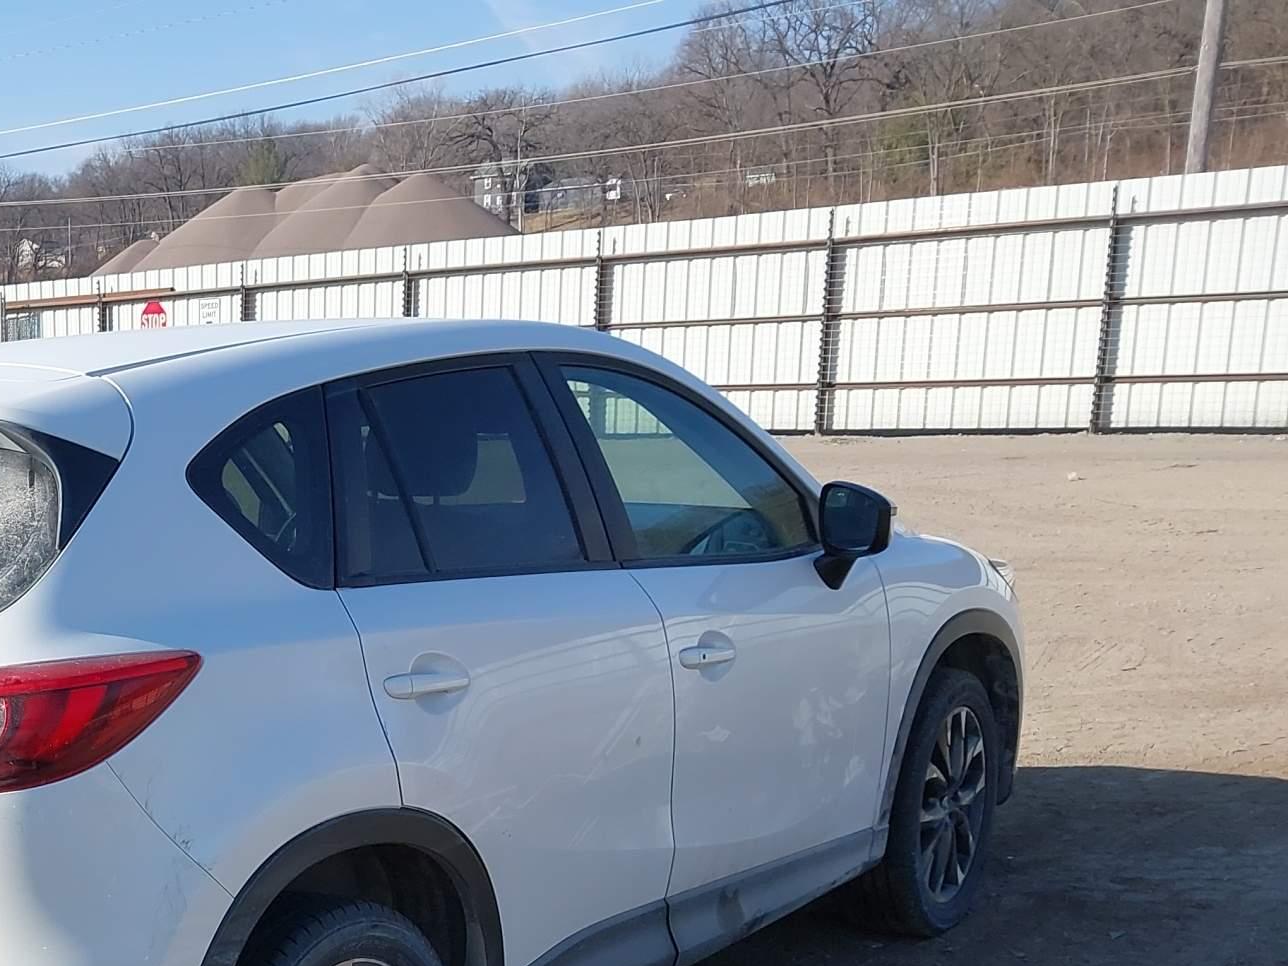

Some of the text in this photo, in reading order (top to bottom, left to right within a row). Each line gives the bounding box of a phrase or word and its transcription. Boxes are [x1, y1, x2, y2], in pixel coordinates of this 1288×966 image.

[201, 302, 219, 310] SPEED
[202, 311, 217, 319] LIMIT
[141, 313, 167, 329] STOP
